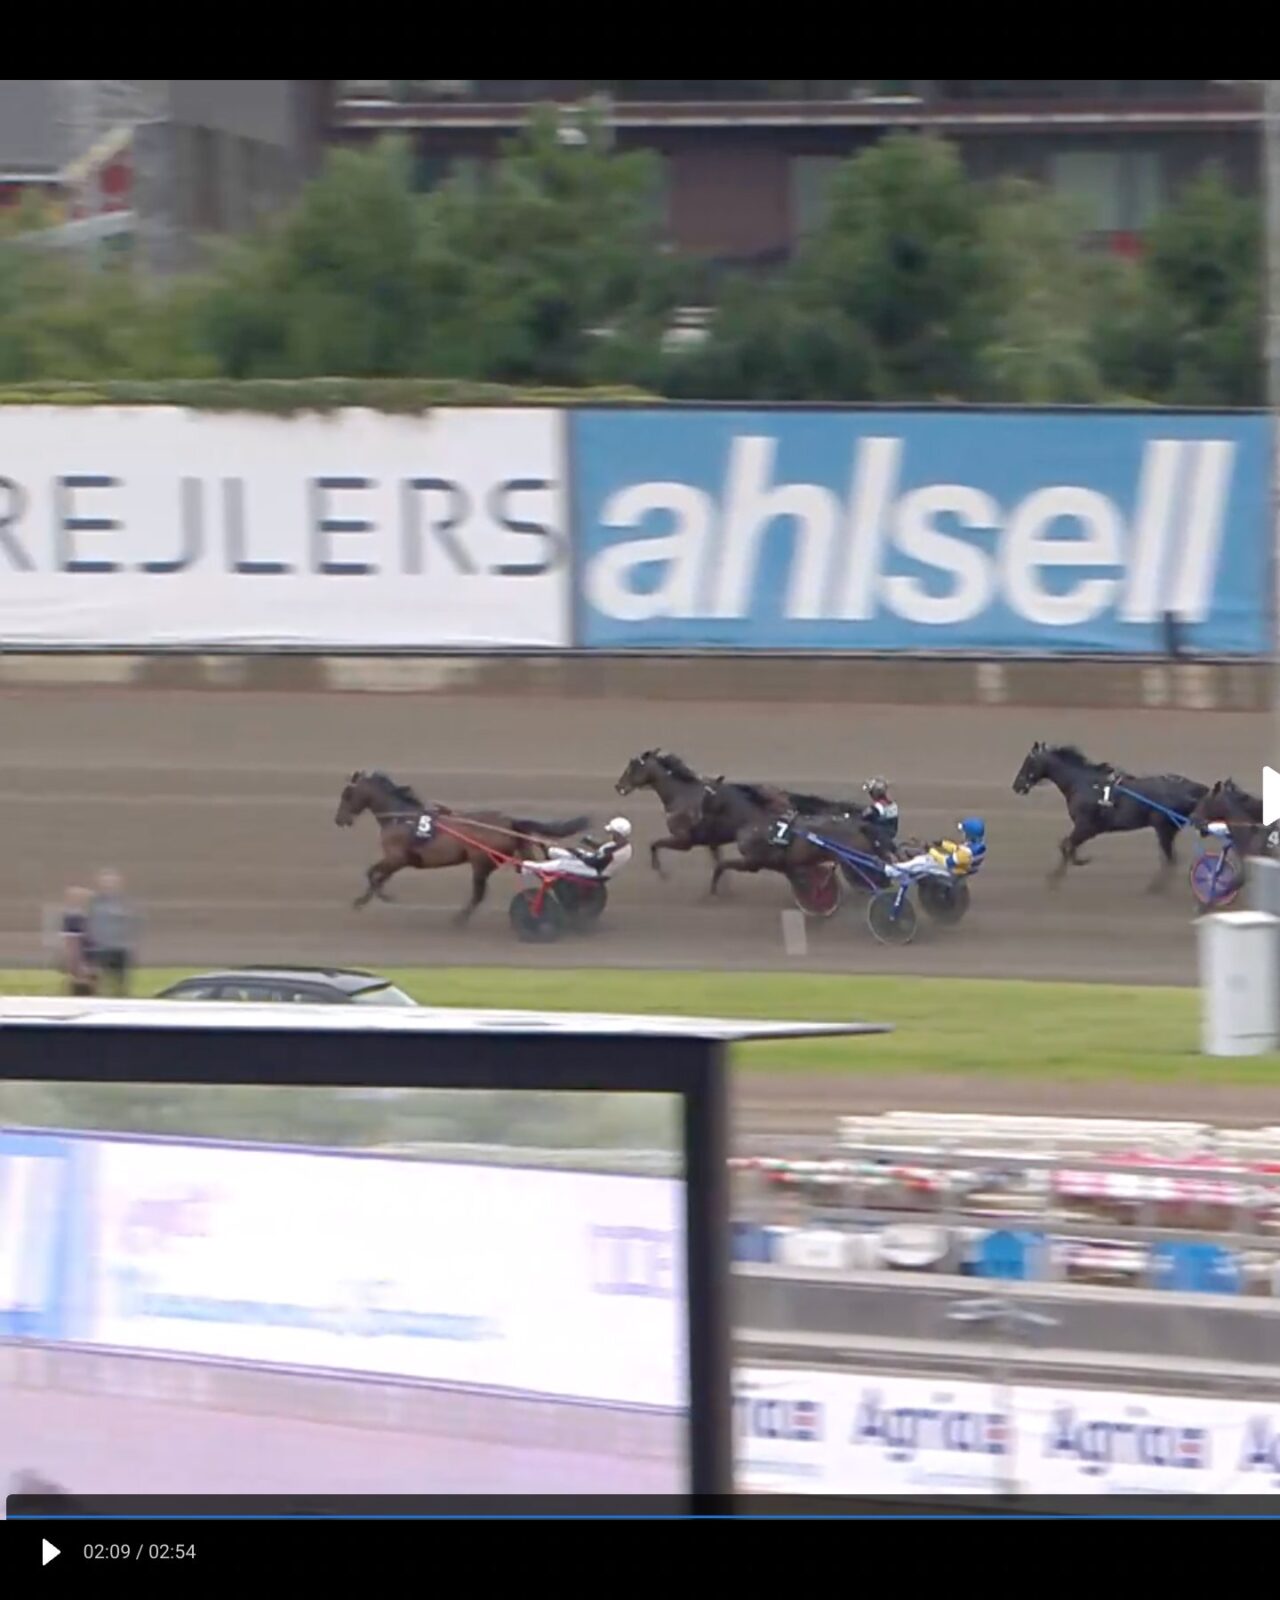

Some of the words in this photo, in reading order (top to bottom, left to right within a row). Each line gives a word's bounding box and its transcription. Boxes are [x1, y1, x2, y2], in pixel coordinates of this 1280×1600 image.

[585, 436, 1237, 625] ahlsell
[418, 815, 432, 833] 5
[776, 821, 788, 838] 7
